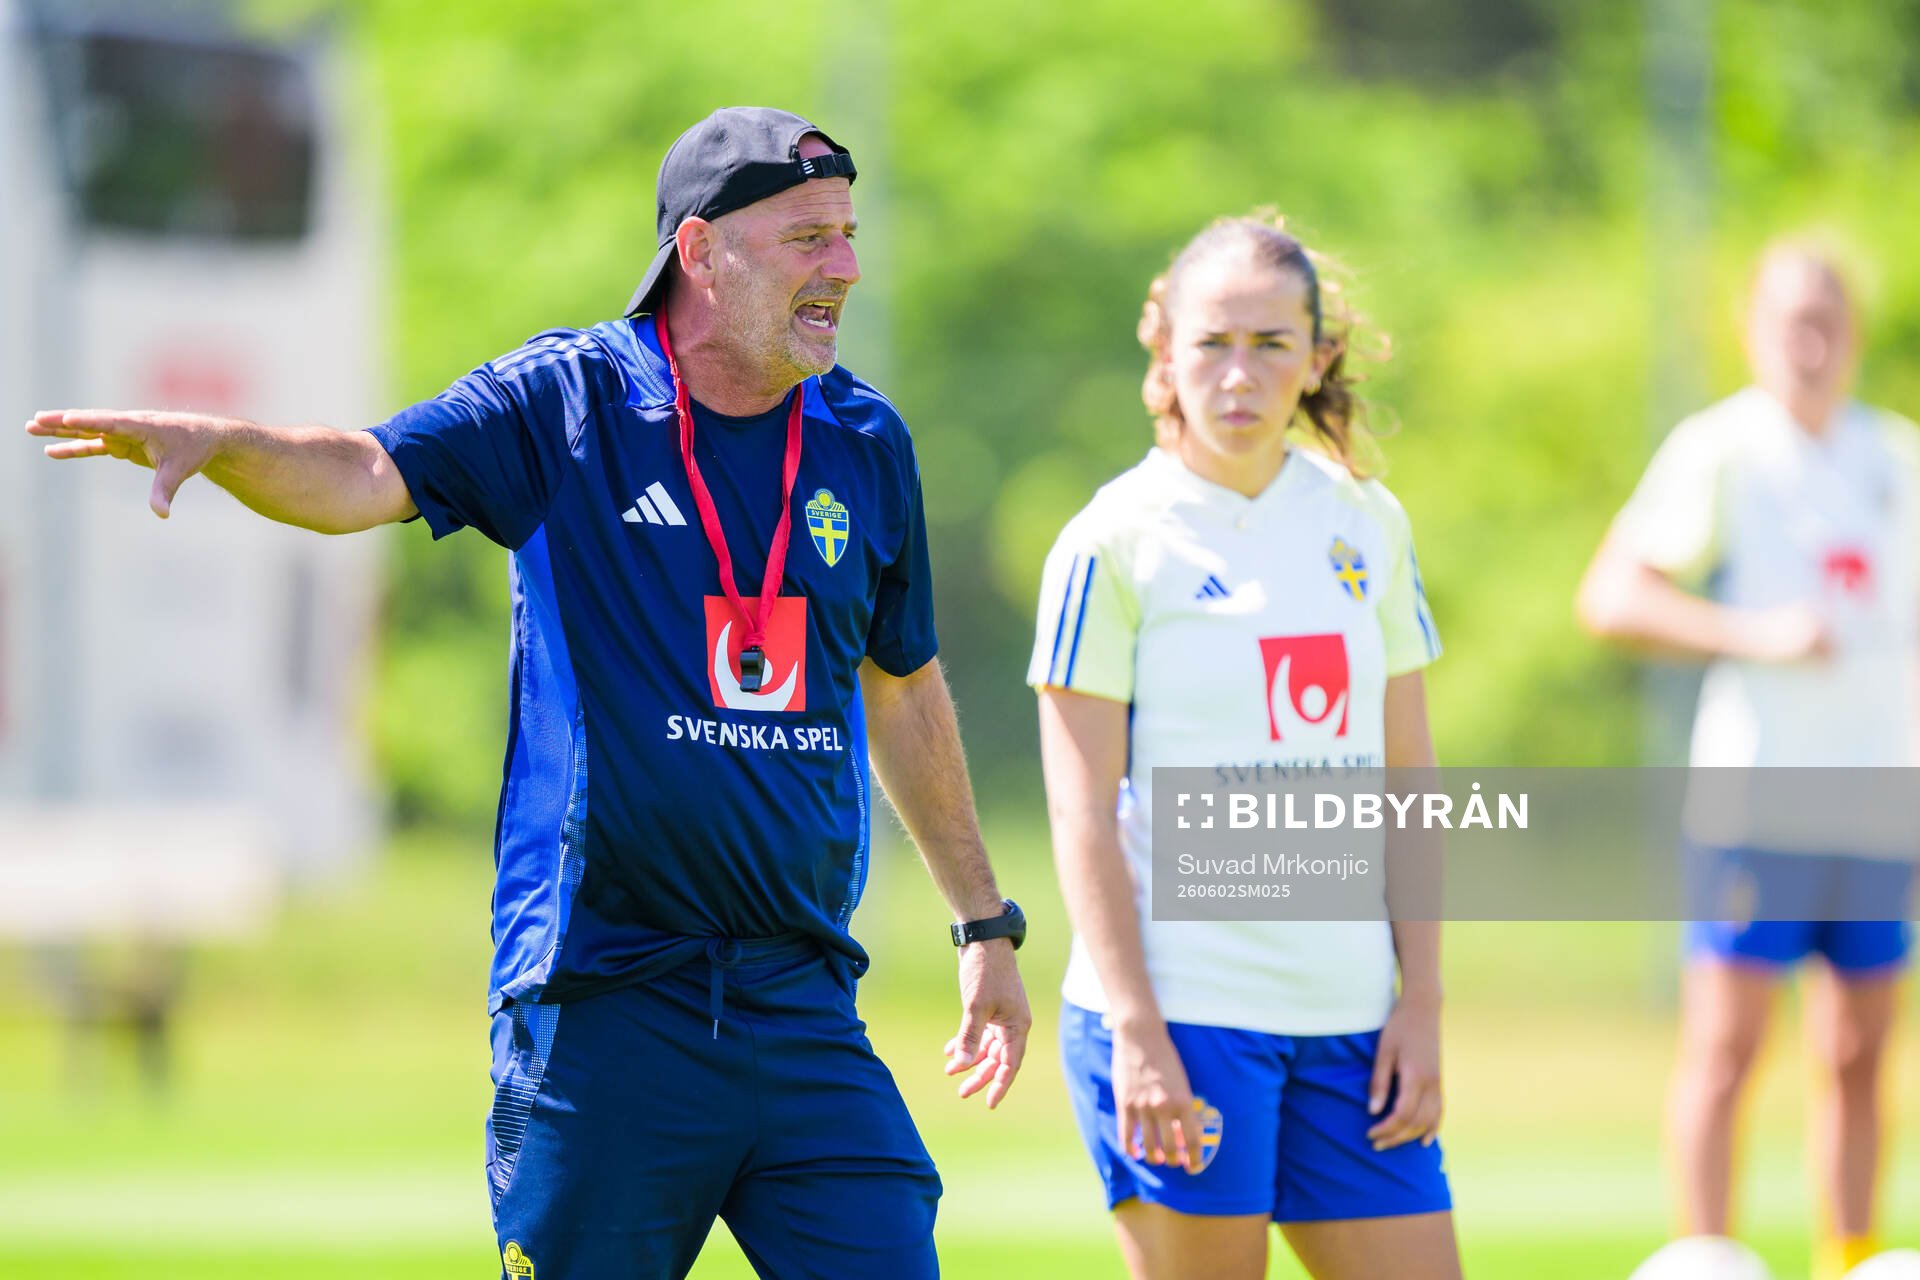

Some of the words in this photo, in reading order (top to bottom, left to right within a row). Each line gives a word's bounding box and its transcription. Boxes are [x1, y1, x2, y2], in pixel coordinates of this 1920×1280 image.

[811, 510, 842, 519] SVERIGE
[666, 714, 789, 750] SVENSKA
[793, 727, 843, 751] SPEL
[1215, 759, 1332, 787] SVENSKA
